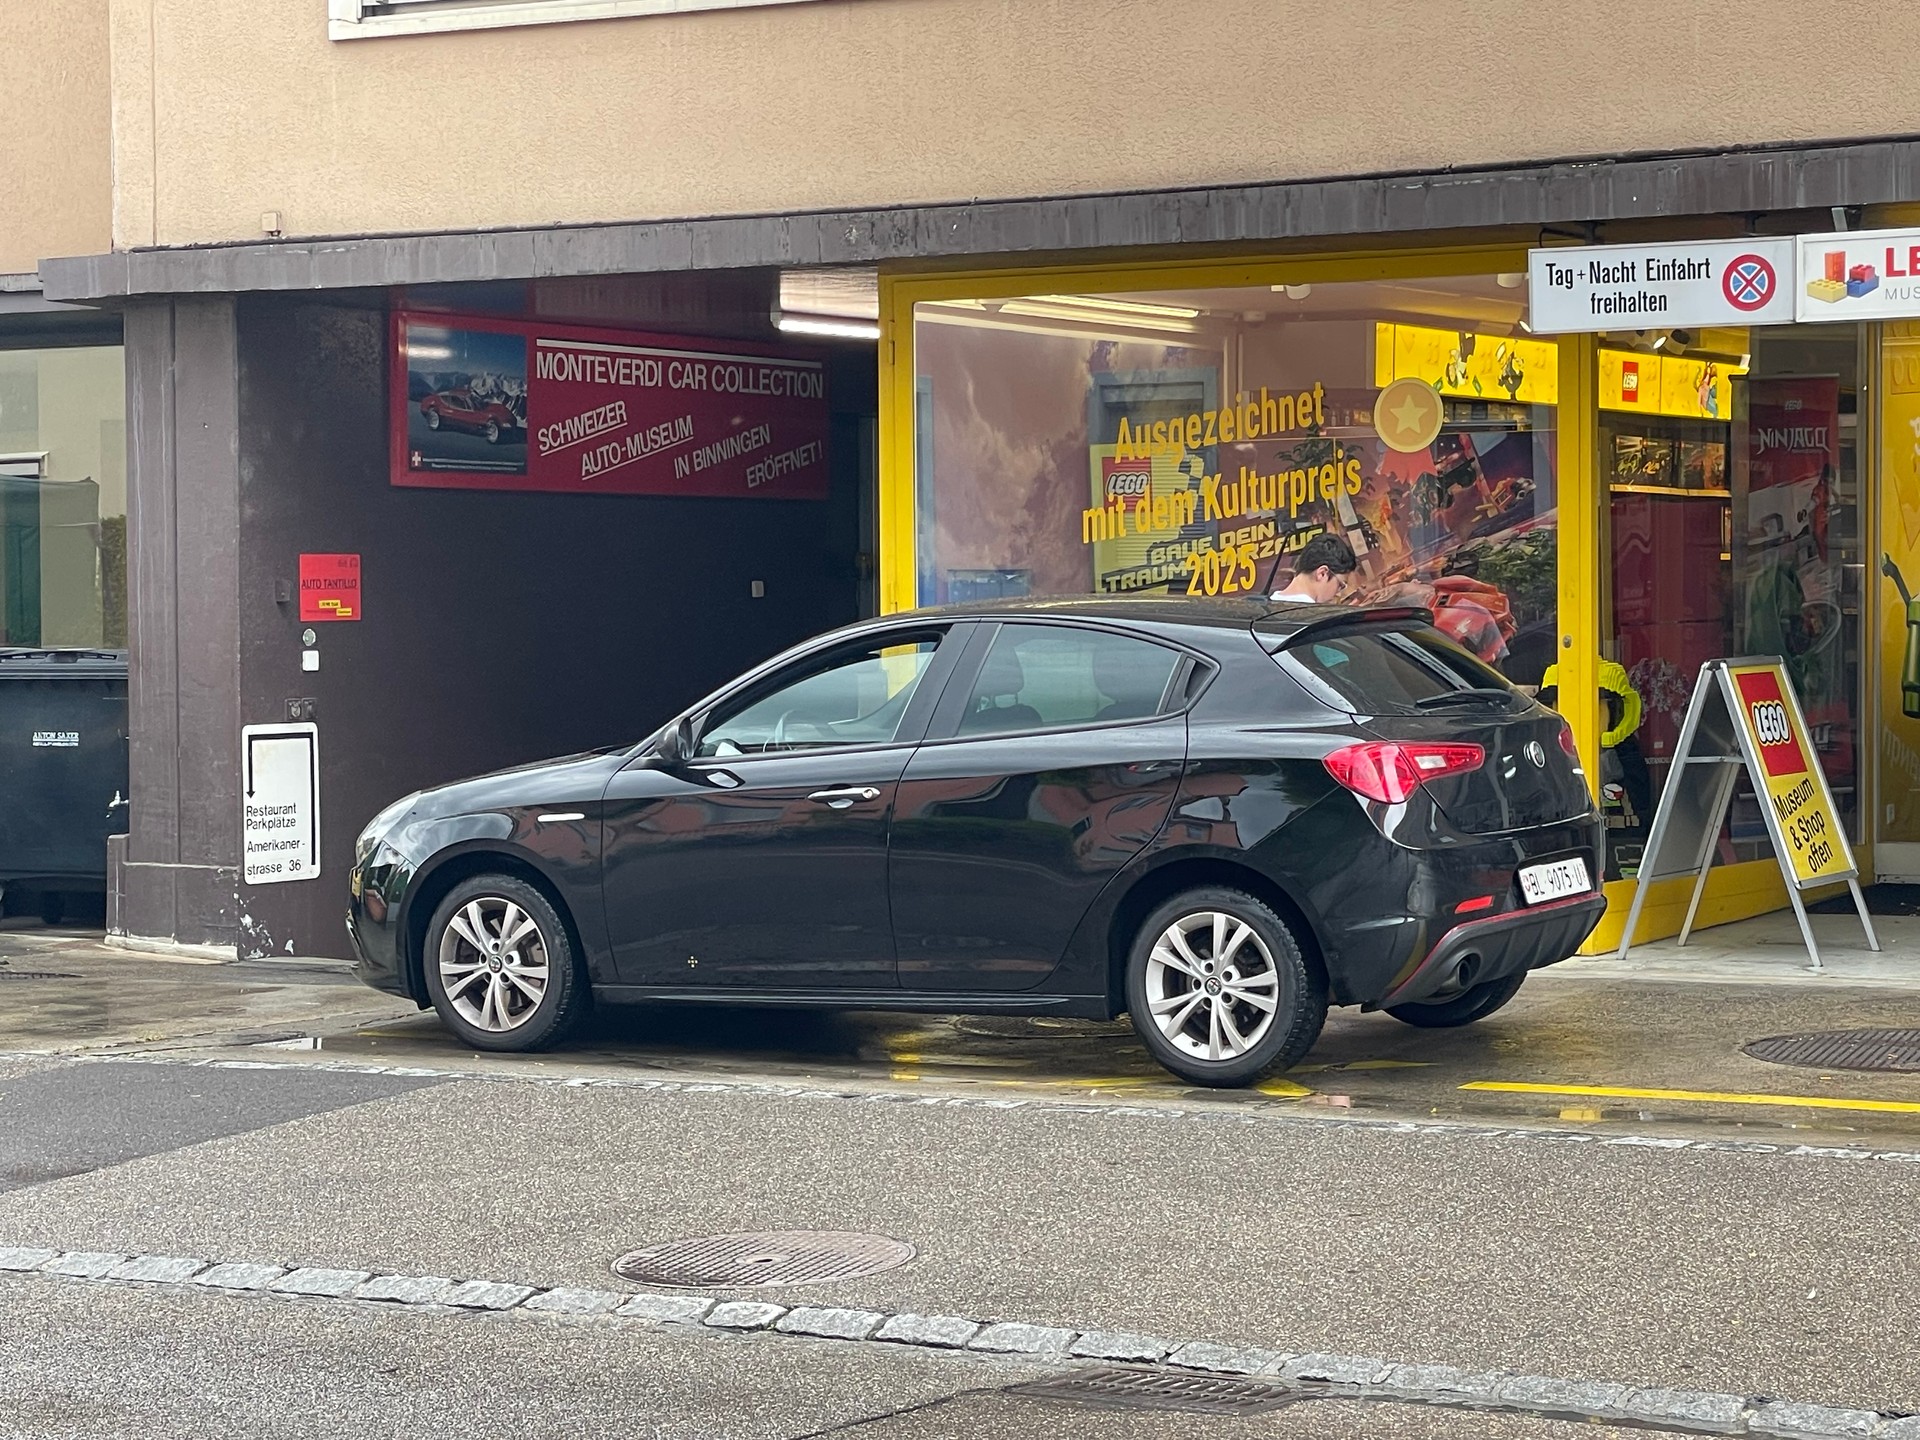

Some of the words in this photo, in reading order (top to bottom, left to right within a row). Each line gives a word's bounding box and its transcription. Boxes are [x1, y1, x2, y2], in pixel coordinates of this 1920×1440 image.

[1646, 256, 1711, 282] Einfahrt
[1590, 291, 1668, 315] freihalten
[536, 352, 662, 387] MONTEVERDI
[668, 361, 707, 391] CAR
[711, 364, 824, 399] COLLECTION
[537, 400, 628, 452] SCHWEIZER
[581, 415, 694, 477] AUTO-MUSEUM
[1115, 382, 1325, 465] Ausgezeichnet
[674, 456, 691, 480] IN
[693, 424, 771, 474] BINNINGEN
[1081, 490, 1127, 544] mit
[1135, 485, 1194, 534] dem
[1204, 448, 1362, 522] Kulturpreis
[1106, 472, 1150, 496] LEGO
[1150, 535, 1213, 566] BAUE
[1219, 521, 1275, 549] DEIN
[302, 578, 322, 590] AUTO
[1186, 543, 1257, 597] 2025
[1753, 701, 1791, 746] LEGO
[246, 802, 297, 817] Restaurant
[1773, 777, 1815, 823] Museum
[246, 817, 297, 832] Parkplätze
[1790, 826, 1803, 851] &
[1798, 810, 1826, 843] Shop
[246, 863, 283, 876] strasse
[289, 859, 302, 872] 36
[1808, 840, 1834, 874] offen
